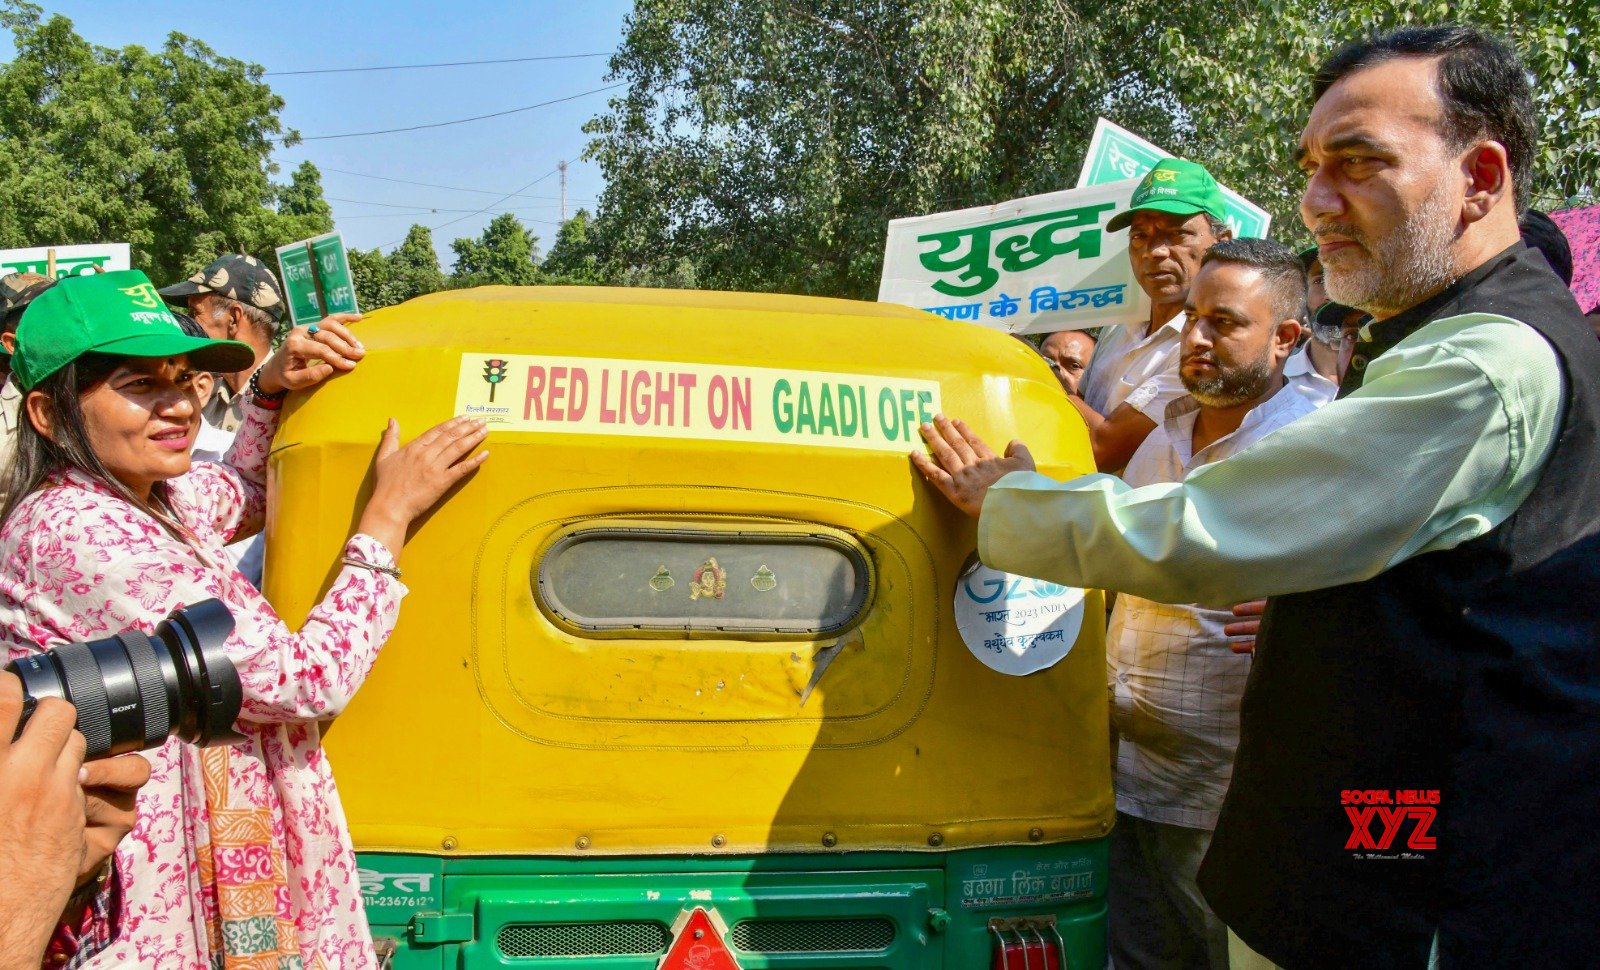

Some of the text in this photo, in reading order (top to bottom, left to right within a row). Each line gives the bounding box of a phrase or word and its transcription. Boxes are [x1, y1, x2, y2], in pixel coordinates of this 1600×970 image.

[917, 202, 1116, 297] युद्ध
[331, 286, 349, 306] OFF
[989, 293, 1022, 318] के
[1029, 284, 1127, 313] विरुद्ध
[523, 366, 933, 442] RED LIGHT ON GAADI OFF
[1015, 609, 1038, 619] 2023
[1041, 603, 1067, 614] INDIA
[112, 703, 137, 714] SONY
[962, 878, 1006, 897] बग्गा
[1011, 870, 1047, 895] लिंक
